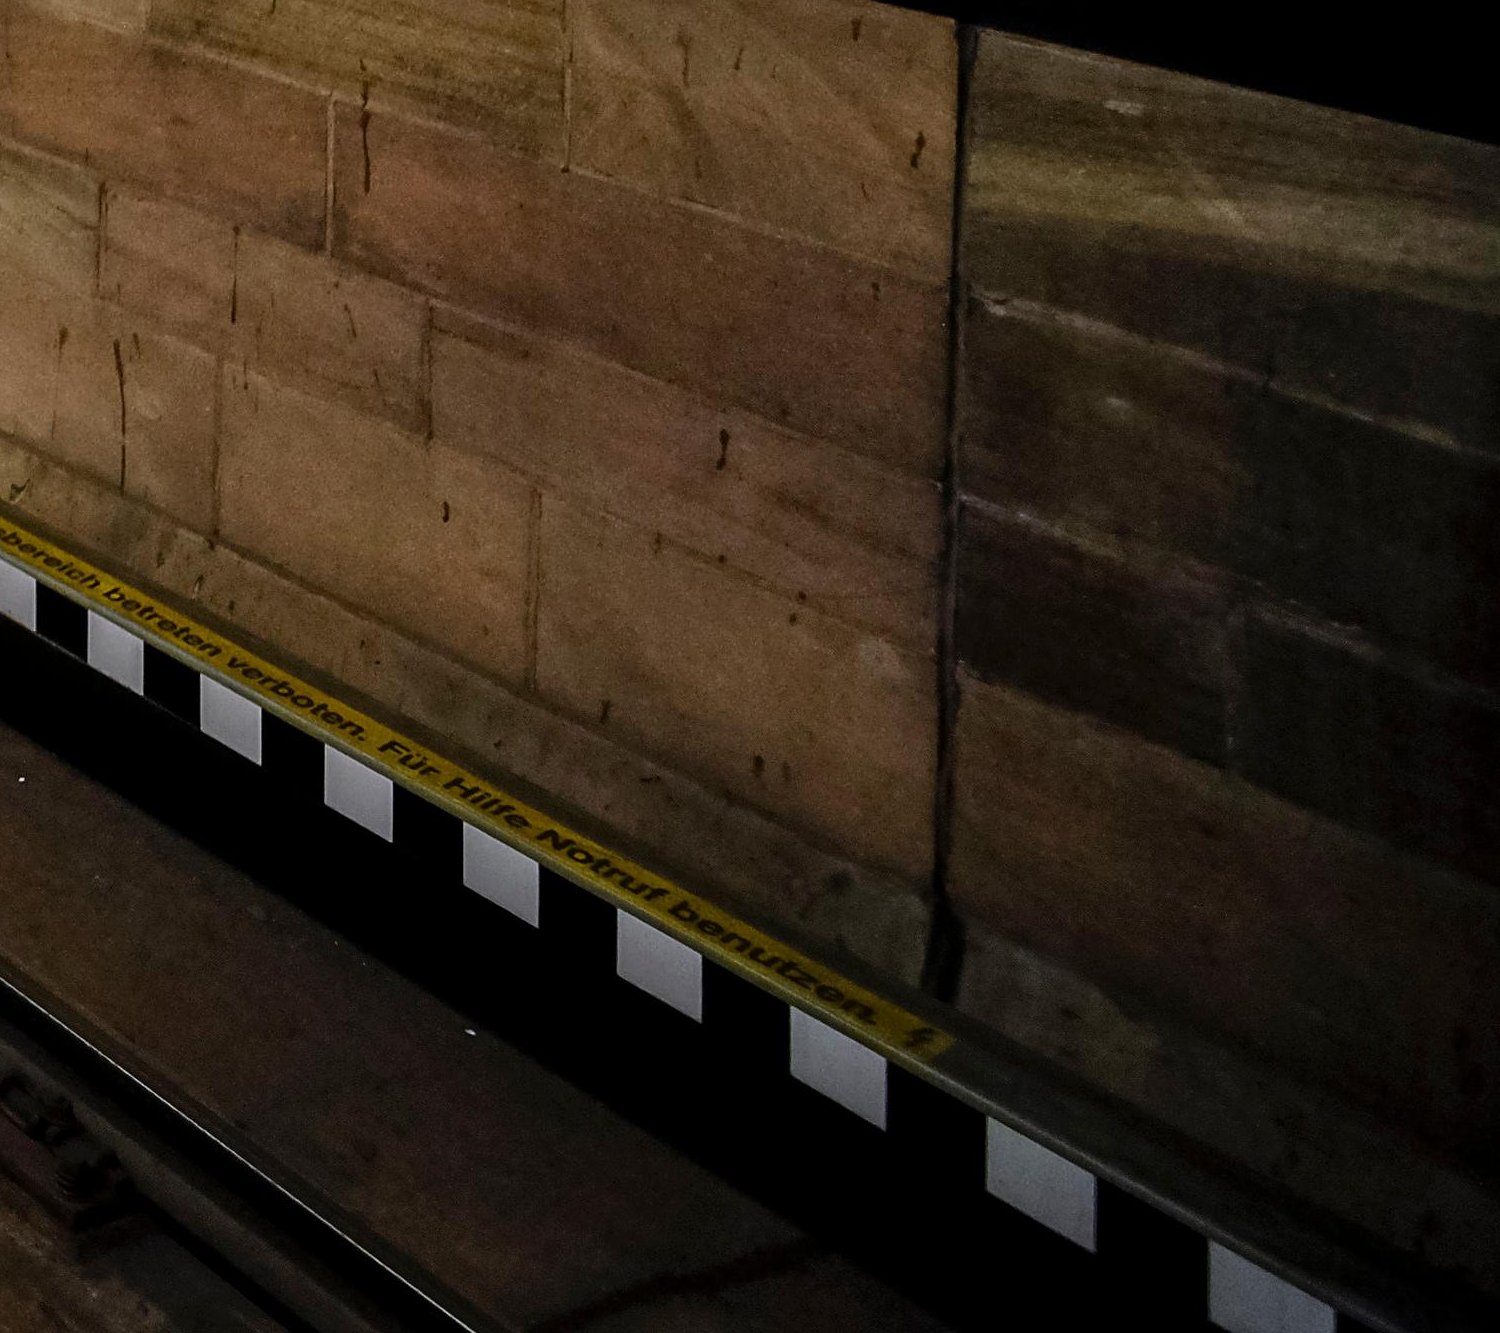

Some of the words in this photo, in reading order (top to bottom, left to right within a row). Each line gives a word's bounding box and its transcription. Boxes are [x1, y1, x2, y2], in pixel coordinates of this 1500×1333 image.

[101, 587, 223, 660] betreten
[226, 654, 368, 743] verboten.
[377, 740, 441, 779] Für
[443, 776, 530, 831] Hilfe
[536, 827, 668, 904] Notruf
[667, 893, 880, 1030] benutzen.
